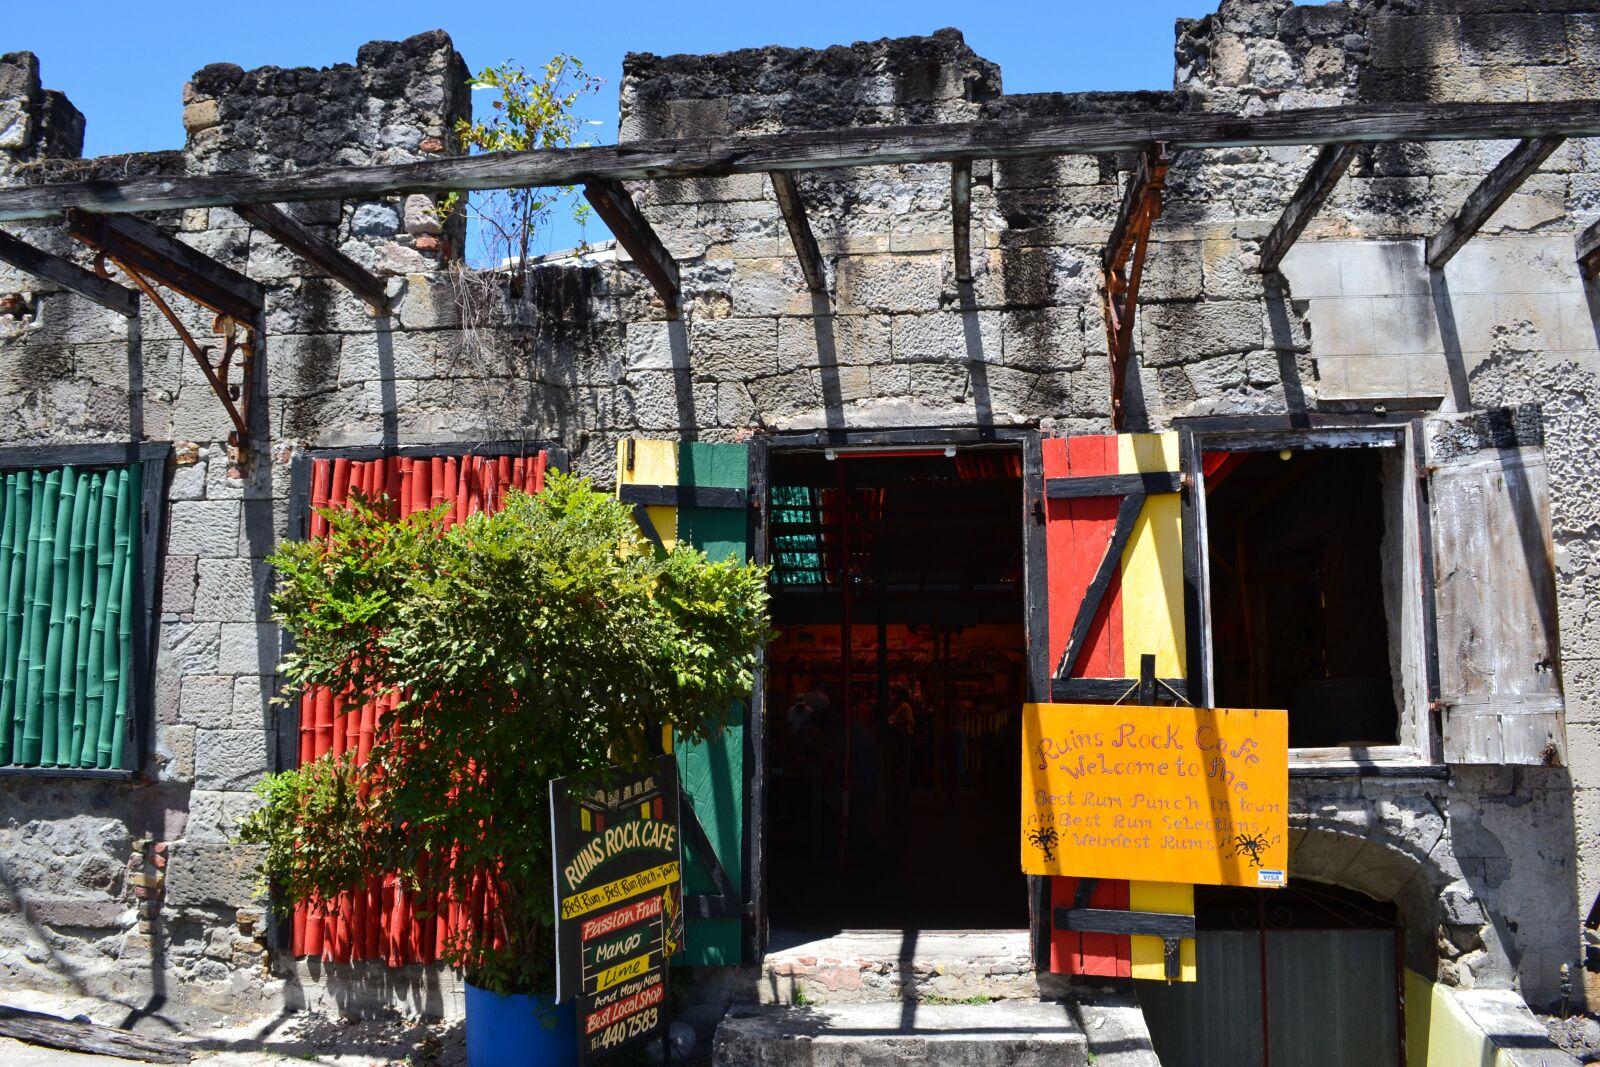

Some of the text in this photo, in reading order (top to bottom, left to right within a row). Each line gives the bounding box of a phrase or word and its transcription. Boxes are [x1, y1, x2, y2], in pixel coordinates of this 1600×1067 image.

[1036, 730, 1103, 770] Ruins
[1196, 726, 1259, 768] Cafe
[1176, 756, 1199, 777] to
[1036, 790, 1075, 806] Best
[1082, 791, 1123, 807] Rum
[1131, 793, 1199, 810] Punch
[1240, 797, 1280, 813] town
[1059, 812, 1100, 827] Best
[1113, 814, 1152, 829] Rum
[564, 837, 605, 890] RUINS
[605, 820, 640, 857] ROCK
[1073, 832, 1215, 851] Weirdest Rums
[563, 895, 583, 917] Best
[581, 892, 601, 910] Rum
[603, 882, 623, 902] Best
[620, 878, 638, 895] Rum
[636, 871, 657, 889] Punch
[583, 895, 662, 940] Passion Fruit
[596, 933, 642, 963] Mango
[604, 960, 641, 987] Lime
[594, 989, 618, 1008] And
[620, 979, 643, 998] Many
[587, 986, 662, 1033] Best Local Shop
[602, 1022, 626, 1050] 440
[627, 1007, 658, 1037] 7583
